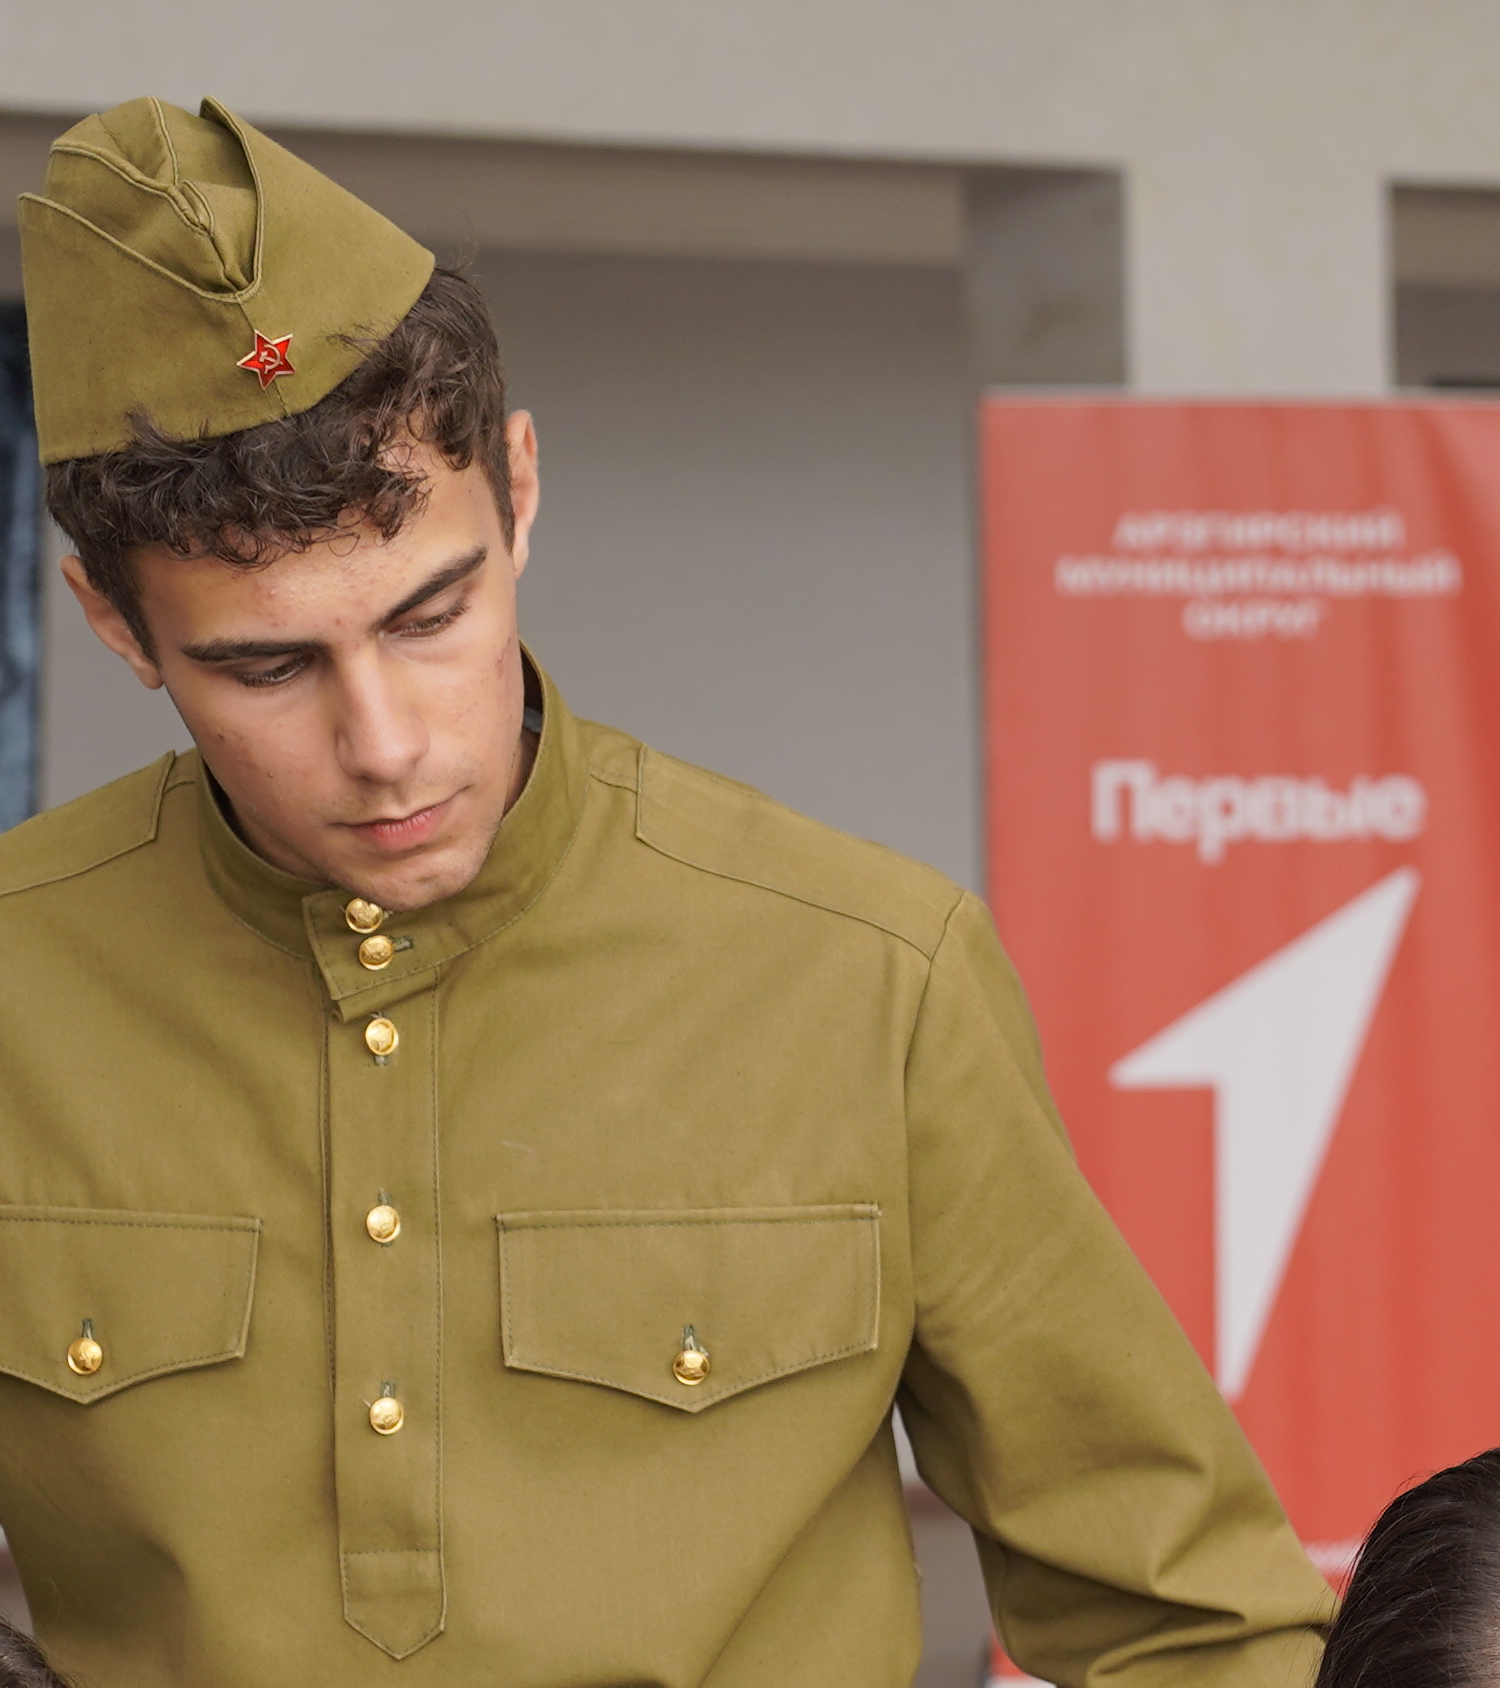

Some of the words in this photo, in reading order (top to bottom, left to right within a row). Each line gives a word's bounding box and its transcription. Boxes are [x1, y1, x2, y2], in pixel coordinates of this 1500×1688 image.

[1055, 550, 1461, 596] МУНИЦИПАЛЬНЫЙ
[1182, 602, 1323, 640] ОКРУГ
[1091, 759, 1427, 864] Первые
